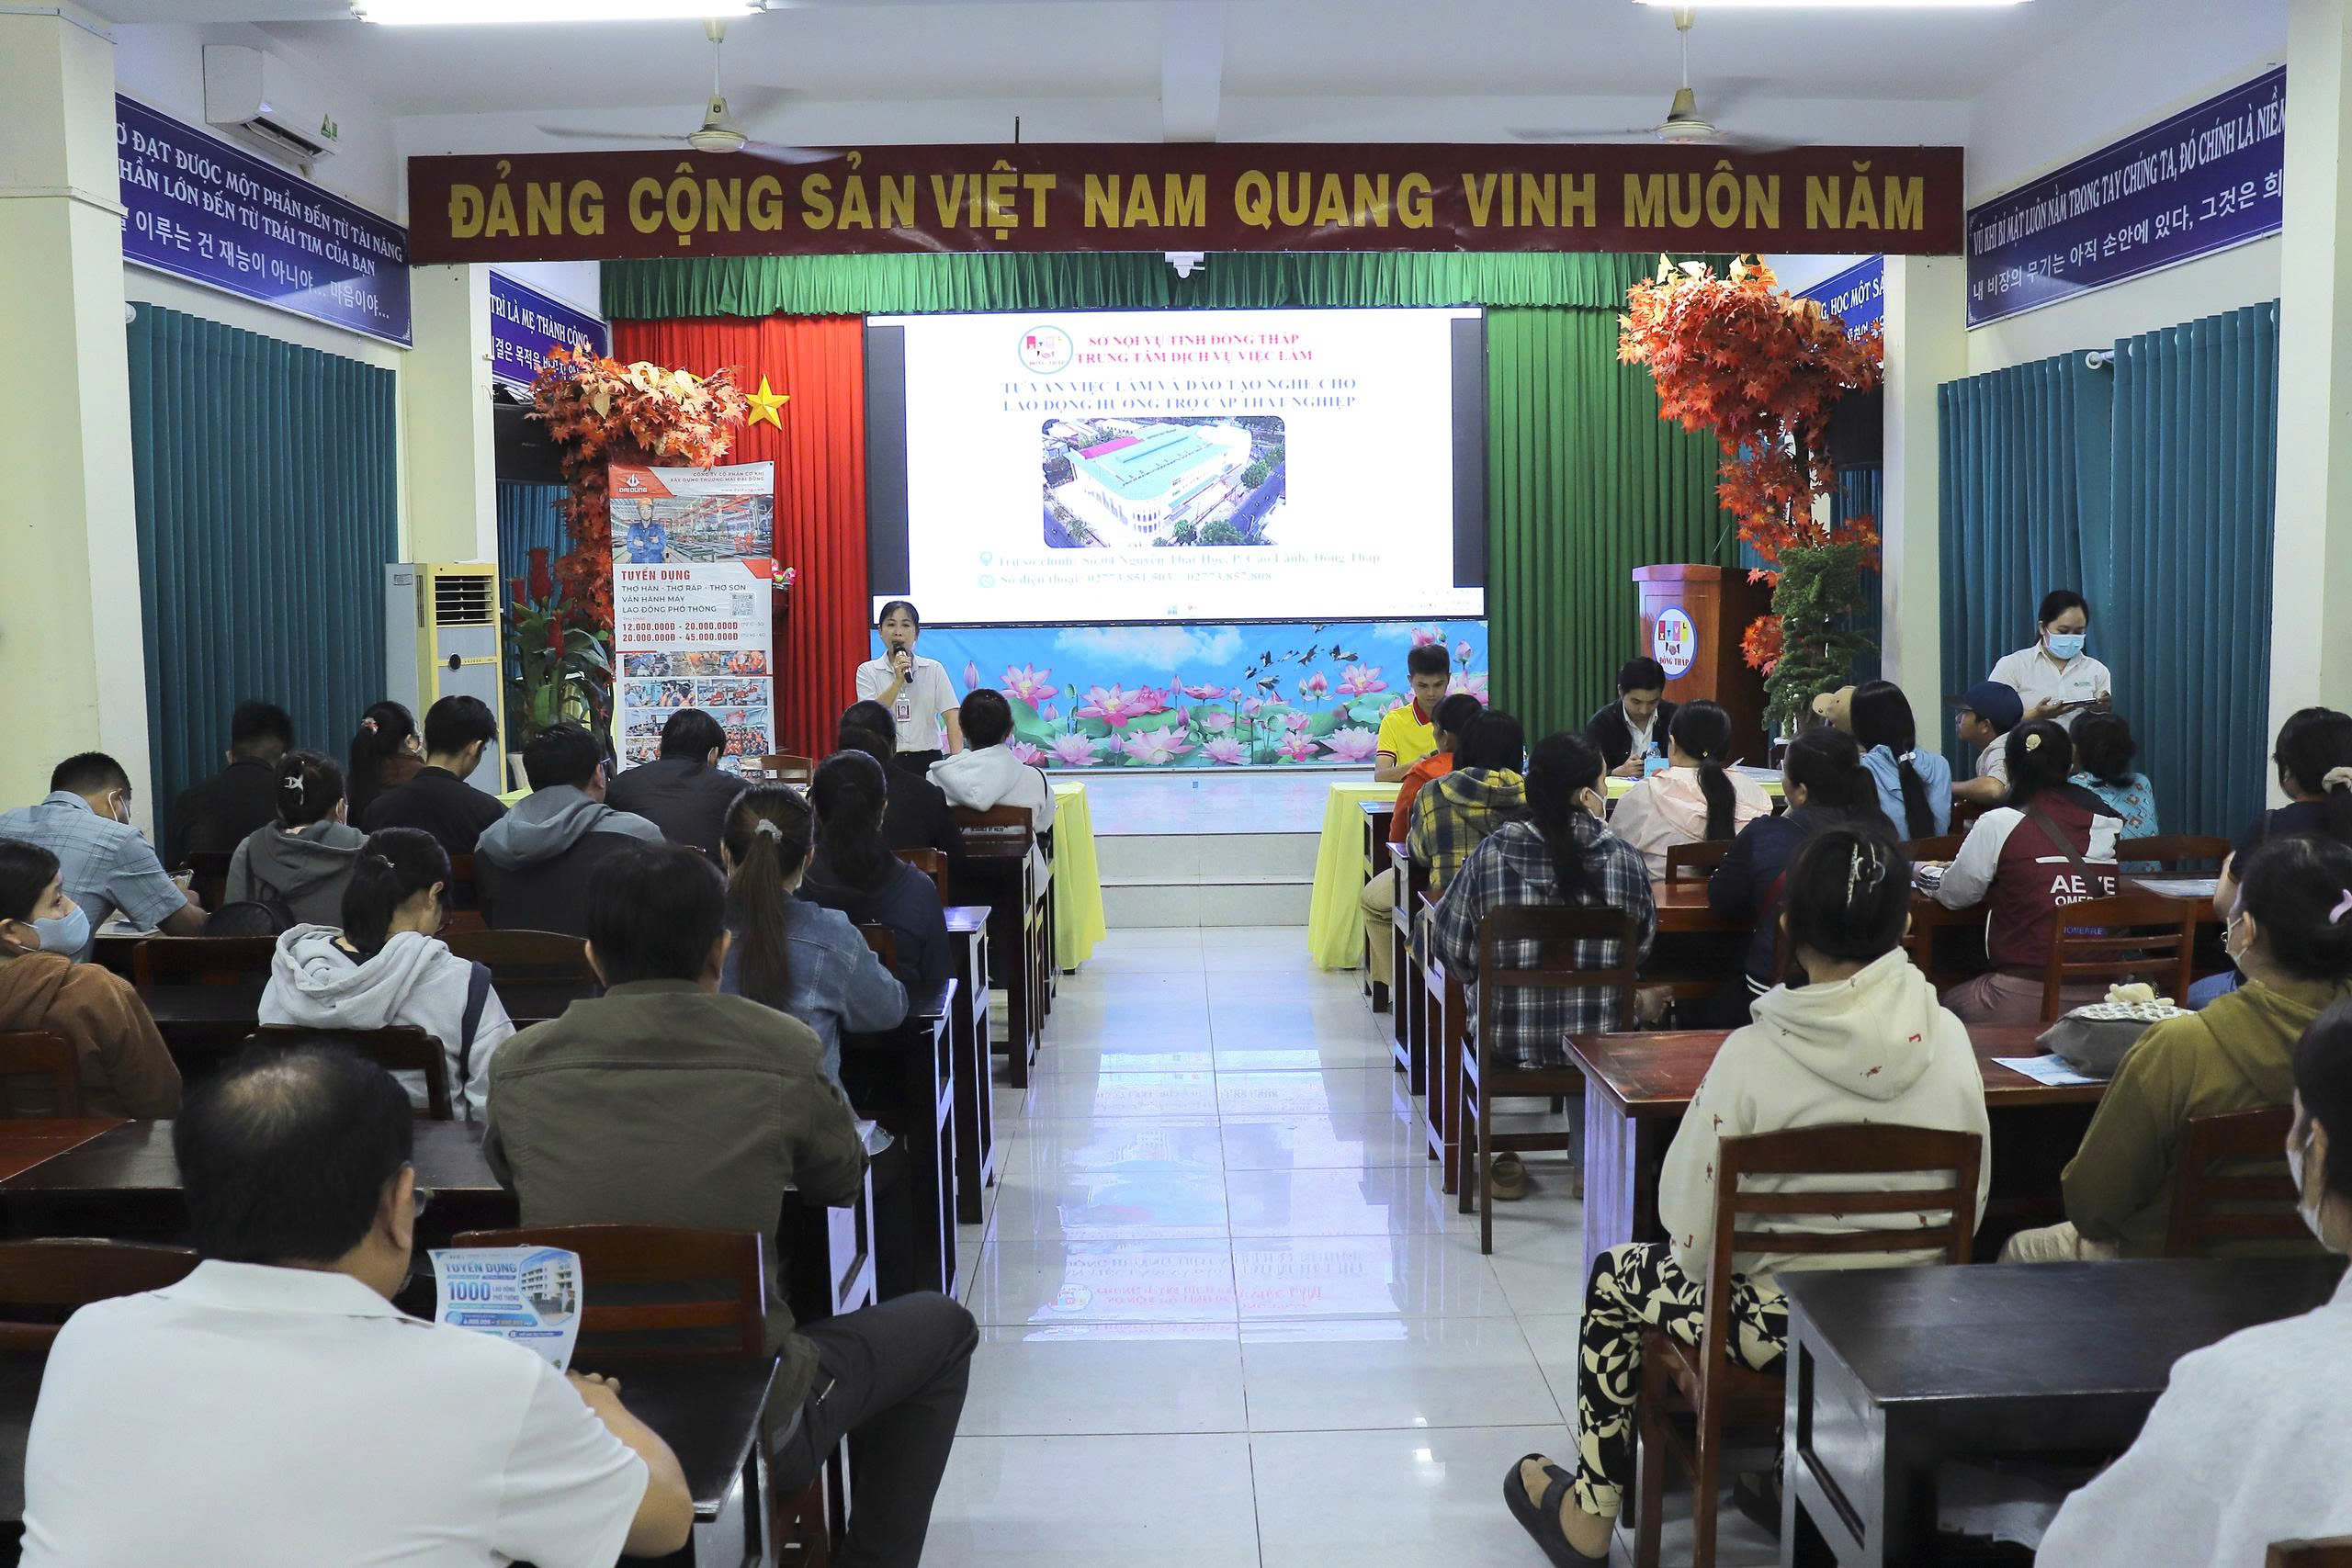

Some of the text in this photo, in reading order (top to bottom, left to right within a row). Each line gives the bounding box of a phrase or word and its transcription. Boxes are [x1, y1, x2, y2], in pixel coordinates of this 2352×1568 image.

[132, 130, 171, 163] ĐẠT
[175, 149, 222, 184] ĐƯỢC
[225, 171, 260, 201] MỘT
[263, 189, 301, 220] PHẦN
[304, 205, 330, 231] ĐẾN
[333, 218, 348, 239] TỪ
[351, 226, 370, 249] TÀI
[372, 237, 402, 263] NĂNG
[449, 152, 1924, 245] ĐẢNG CỘNG SẢN VIỆT NAM QUANG VINH MUÔN NĂM
[1984, 215, 1997, 252] KHÍ
[1998, 211, 2006, 247] BÍ
[2007, 207, 2024, 248] MẬT
[2025, 197, 2047, 235] LUÔN
[2069, 177, 2099, 218] TRONG
[2101, 169, 2121, 204] TAY
[2123, 152, 2157, 196] CHÚNG
[2160, 147, 2177, 182] TA,
[2179, 129, 2196, 174] ĐÓ
[2199, 118, 2235, 165] CHÍNH
[2237, 104, 2254, 150] LÀ
[136, 210, 191, 252] 이루는
[198, 231, 213, 259] 건
[220, 240, 265, 278] 재능이
[164, 176, 198, 206] LỚN
[202, 190, 235, 221] ĐẾN
[239, 207, 259, 230] TỪ
[262, 220, 295, 245] TRÁI
[298, 231, 322, 256] TIM
[325, 240, 349, 267] CỦA
[352, 254, 375, 277] BẠN
[1973, 280, 1984, 300] 내
[1987, 265, 2022, 295] 비장의
[2027, 254, 2065, 283] 무기는
[2070, 238, 2097, 267] 아직
[2103, 219, 2148, 257] 손안에
[2155, 205, 2193, 240] 있다,
[2199, 181, 2256, 220] 그것은
[490, 294, 506, 318] TRÌ
[507, 299, 520, 324] LÀ
[522, 308, 535, 334] MẸ
[537, 315, 566, 343] THÀNH
[1830, 292, 1849, 318] HỌC
[1850, 280, 1871, 309] MỘT
[1077, 352, 1129, 365] TRUNG
[621, 567, 690, 582] TUYỂN DỤNG
[2050, 874, 2116, 896] AEE
[448, 1281, 491, 1301] 1000
